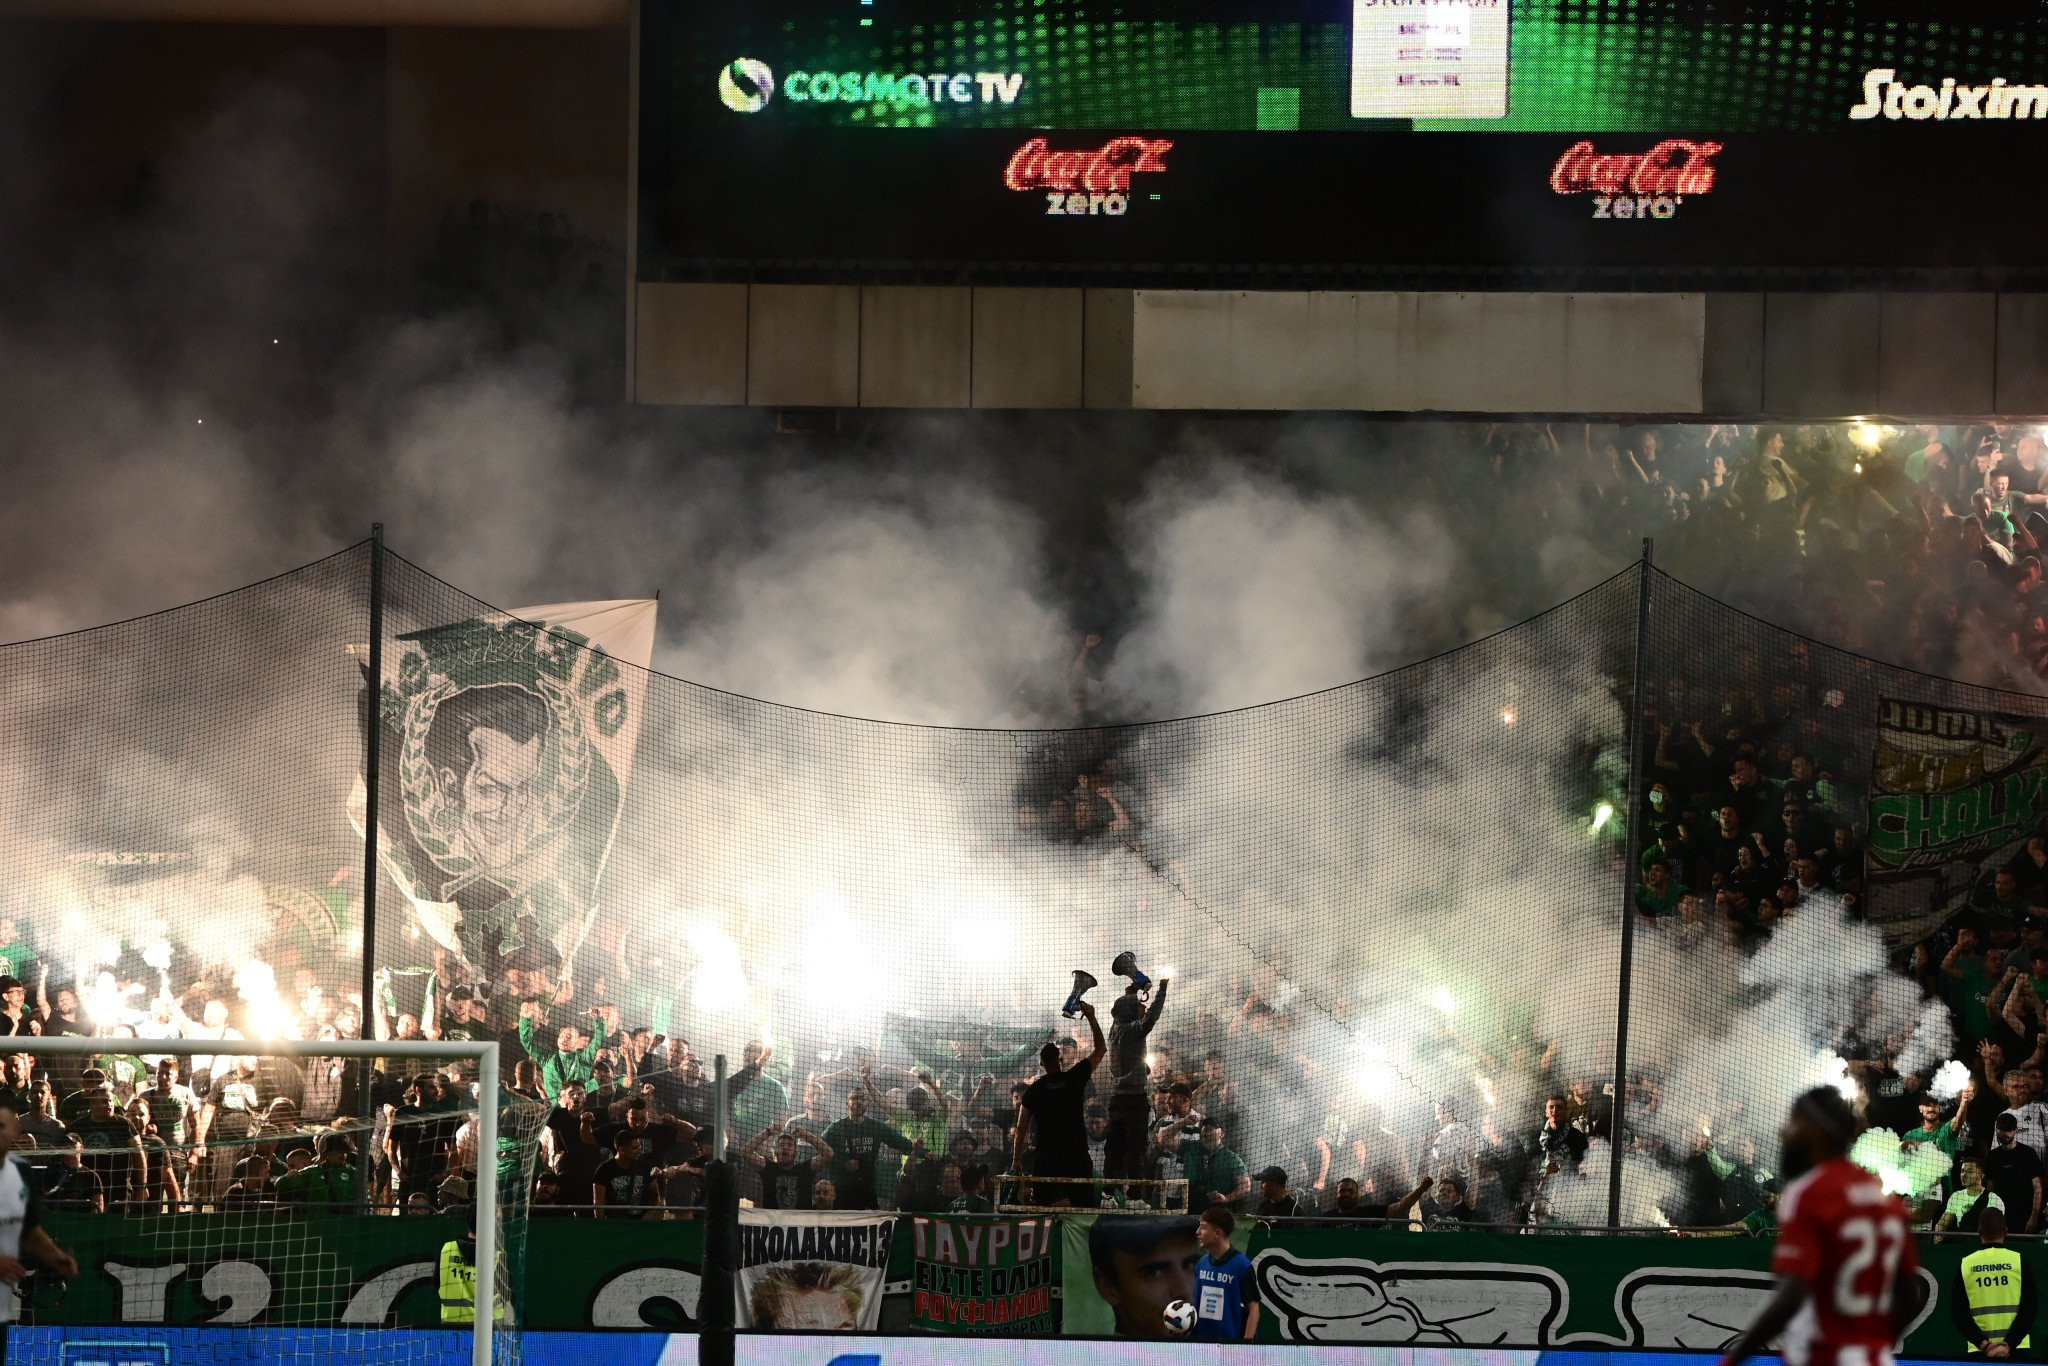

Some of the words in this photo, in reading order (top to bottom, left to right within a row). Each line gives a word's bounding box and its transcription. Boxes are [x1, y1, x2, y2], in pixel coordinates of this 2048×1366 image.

[784, 72, 972, 102] COSMOTE
[976, 73, 1023, 103] TV
[1004, 136, 1175, 191] Coca-Col
[1046, 192, 1127, 215] zero
[914, 1260, 984, 1297] ΕΙΣΤΕ
[990, 1257, 1051, 1297] ΟΛΟΙ
[1199, 1269, 1215, 1281] BALL
[1217, 1272, 1234, 1284] BOY
[1975, 1275, 2009, 1287] 1018
[1976, 1263, 2012, 1272] BRINKS
[914, 1287, 1050, 1325] ΡΟΥΦΙΑΝΟΙ
